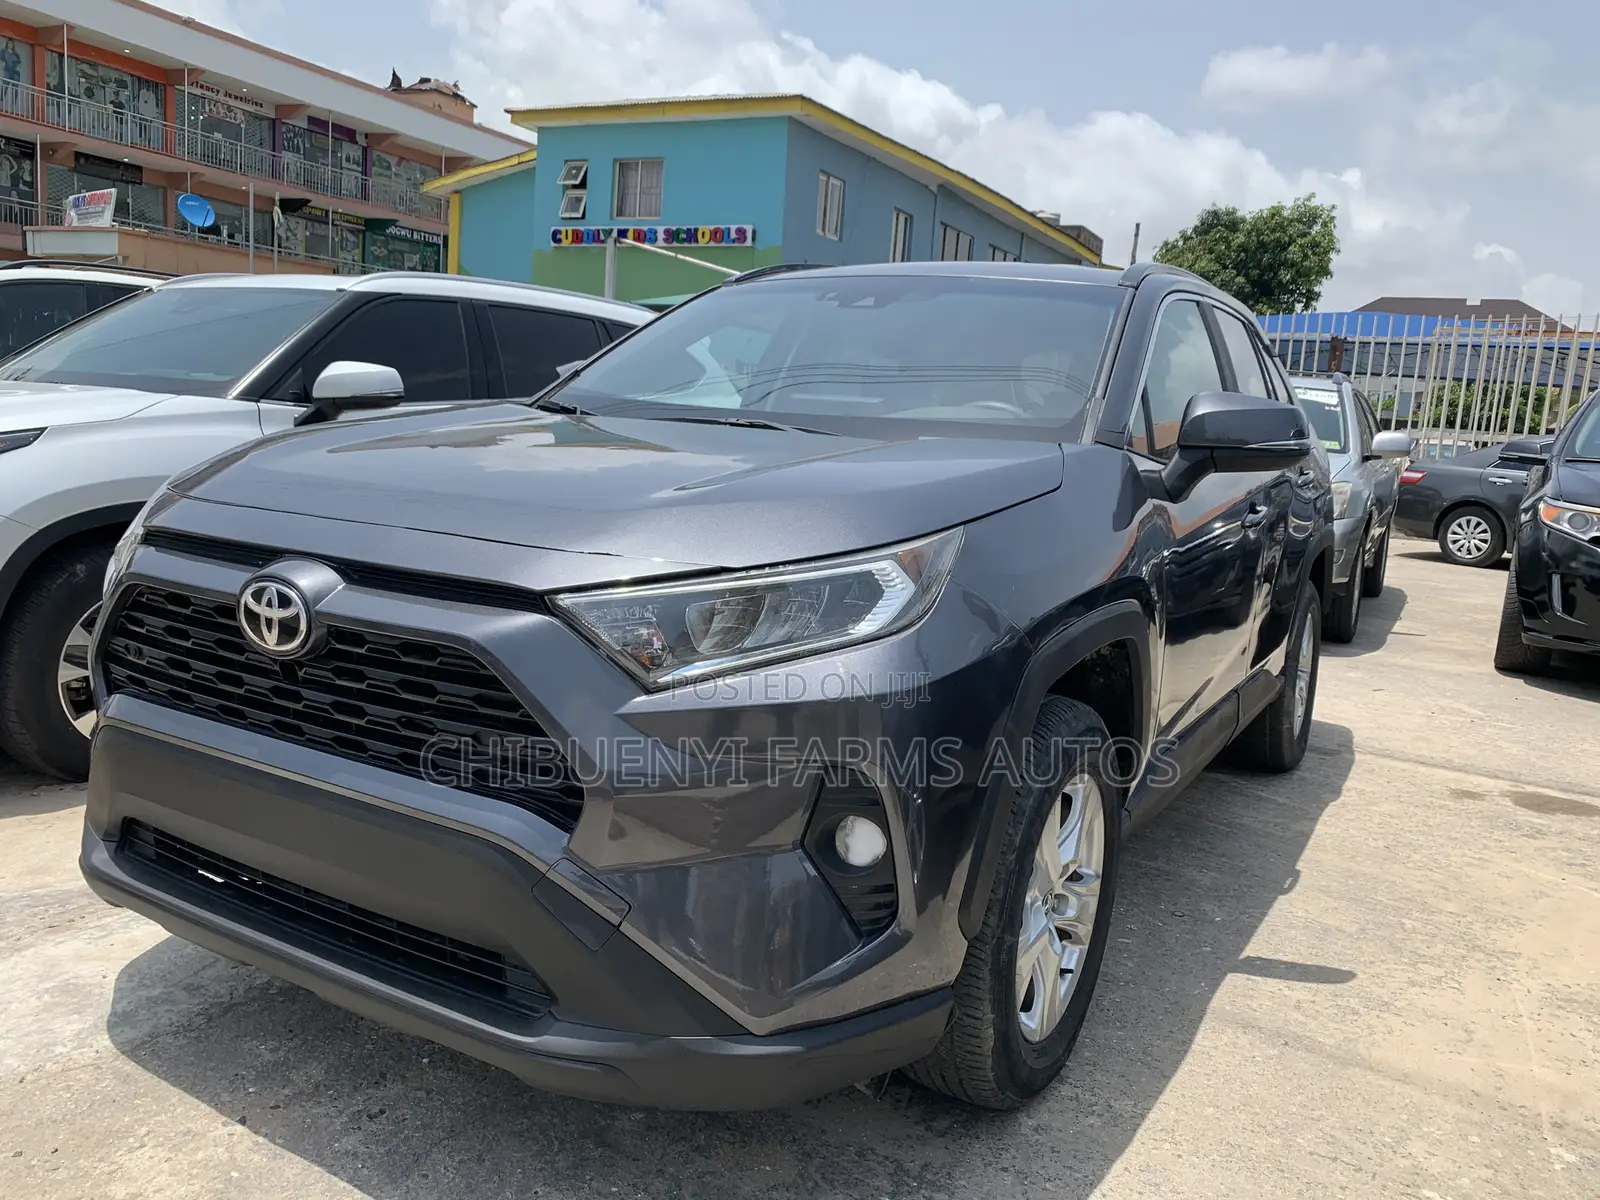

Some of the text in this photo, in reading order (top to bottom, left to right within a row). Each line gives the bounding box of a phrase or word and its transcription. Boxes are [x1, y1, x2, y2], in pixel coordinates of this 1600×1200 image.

[223, 90, 264, 109] Jewelries
[551, 227, 748, 244] CUDDLY KIDS SCHOOLS
